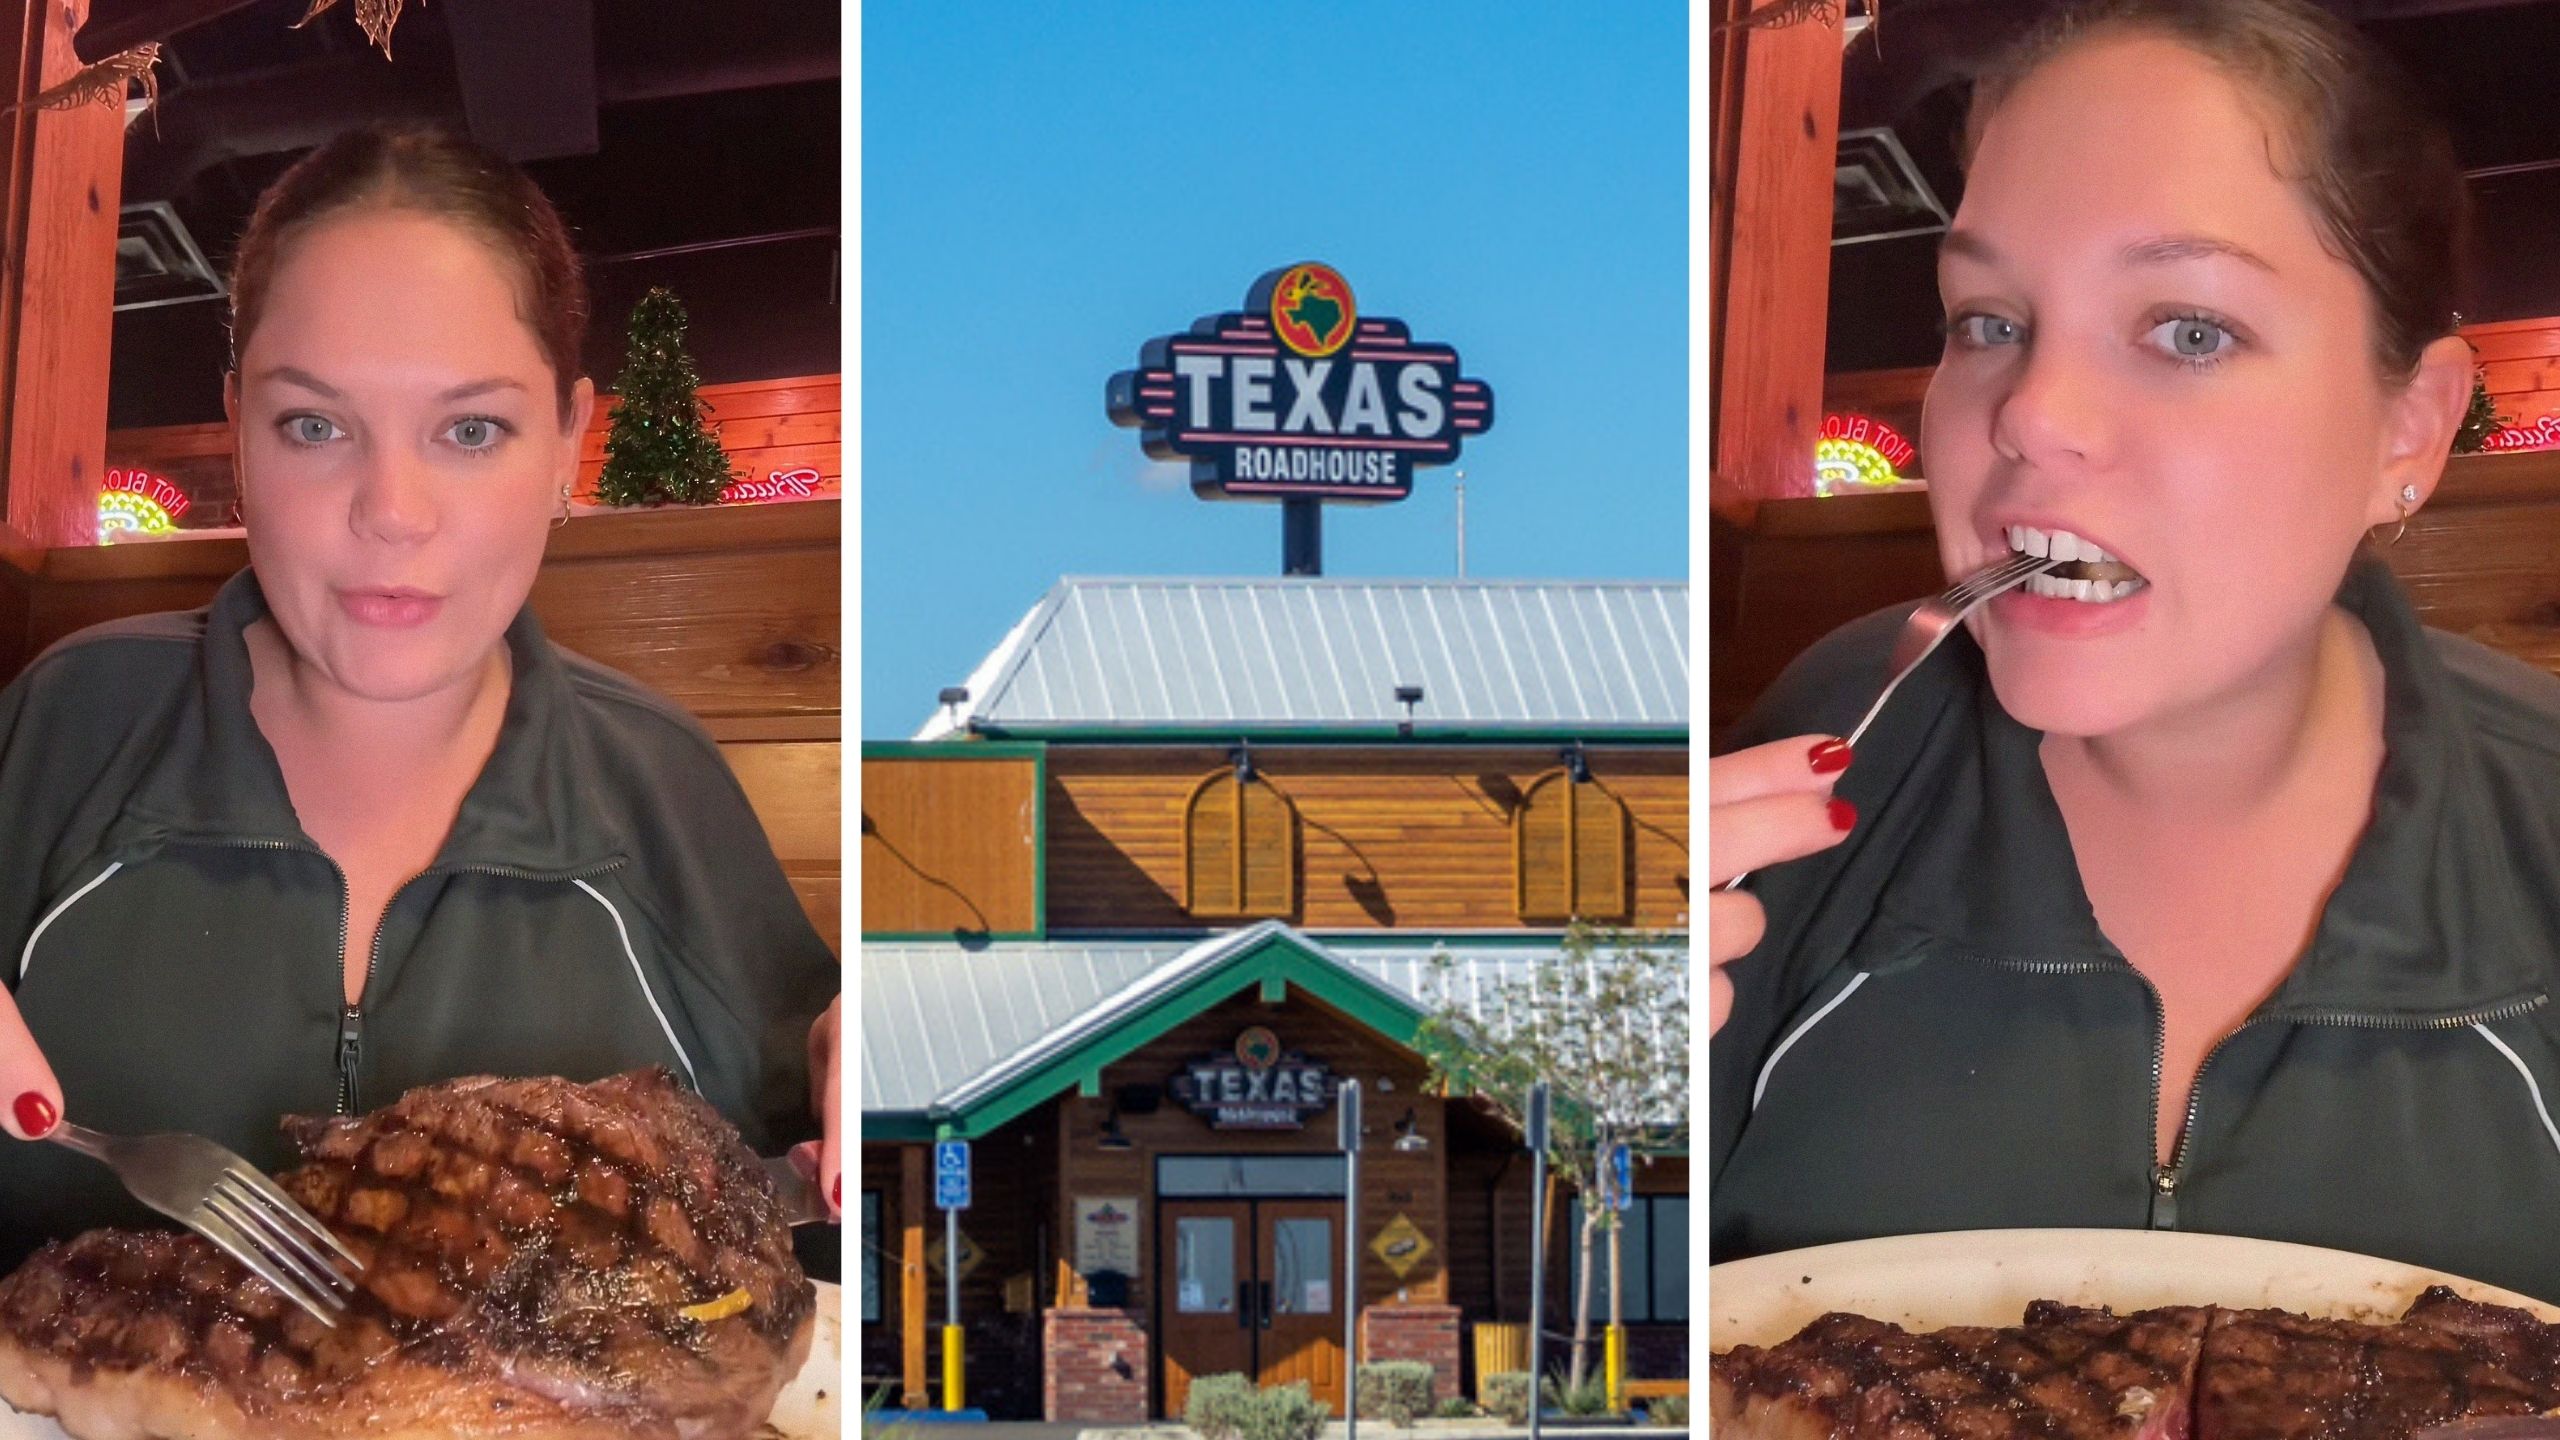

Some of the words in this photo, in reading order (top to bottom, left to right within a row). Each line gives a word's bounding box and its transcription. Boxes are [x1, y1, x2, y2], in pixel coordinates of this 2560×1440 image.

[1175, 355, 1446, 439] TEXAS
[1234, 446, 1397, 484] ROADHOUSE
[1193, 1069, 1324, 1102] TEXAS
